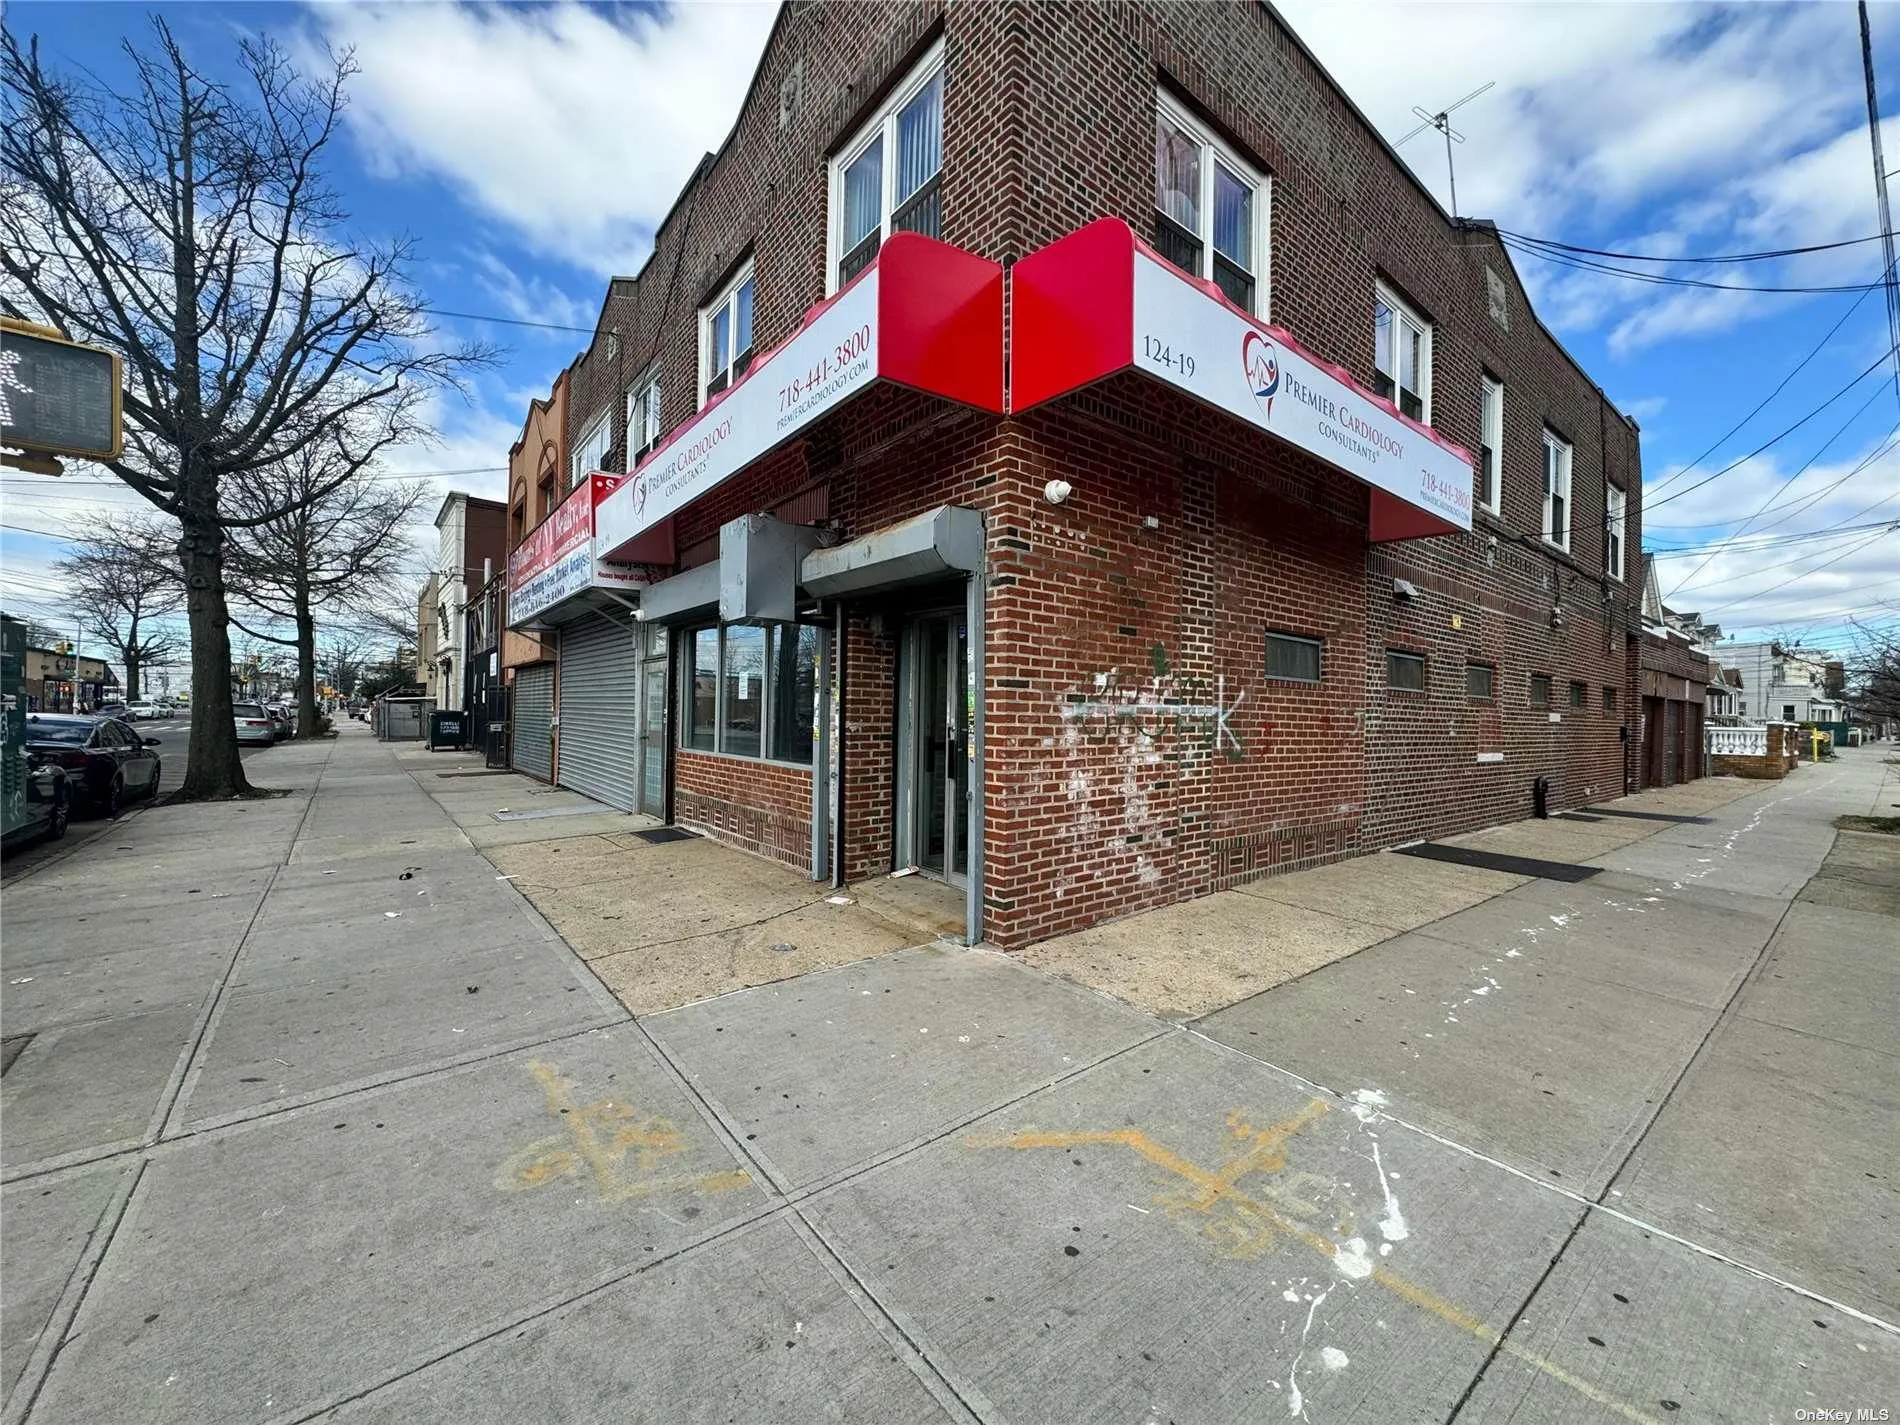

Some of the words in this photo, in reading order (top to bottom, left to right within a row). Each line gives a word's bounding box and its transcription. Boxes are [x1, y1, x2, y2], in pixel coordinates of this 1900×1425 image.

[779, 324, 870, 412] 718-441-3800
[1143, 334, 1195, 377] 124-19
[777, 359, 869, 432] PREMIERCARDIOLOGY.COM
[1284, 371, 1337, 421] PREMIER
[1339, 406, 1405, 460] CARDIOLOGY
[648, 461, 677, 494] PREMIER
[677, 415, 733, 472] CARDIOLOGY
[1420, 468, 1471, 510] 718-441-3800
[552, 527, 590, 560] COMMERCIAL
